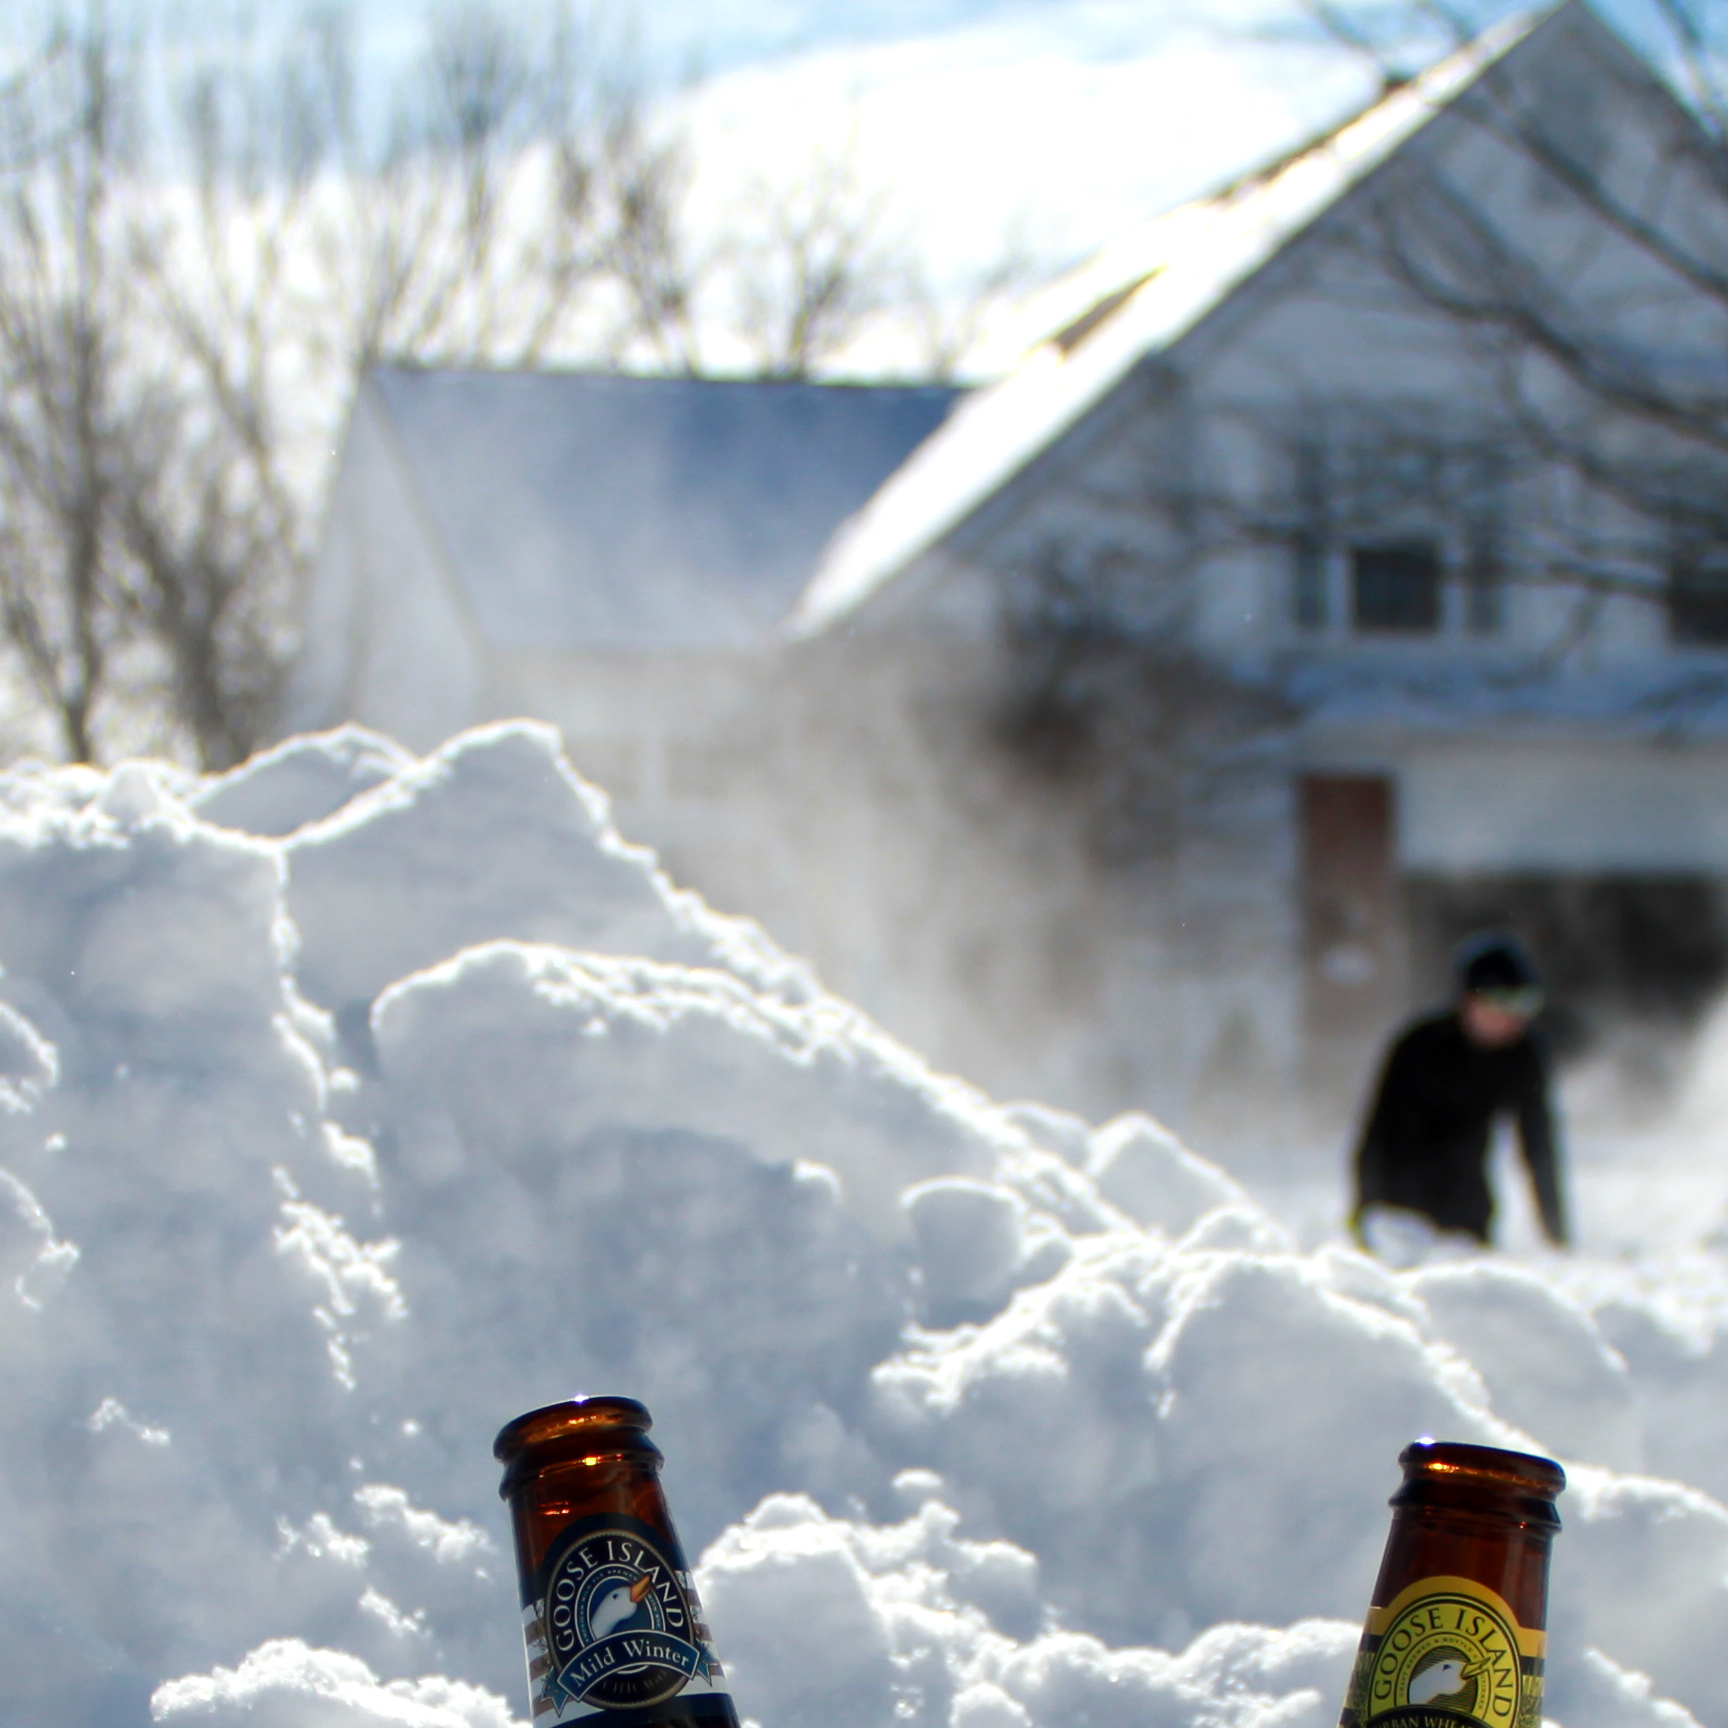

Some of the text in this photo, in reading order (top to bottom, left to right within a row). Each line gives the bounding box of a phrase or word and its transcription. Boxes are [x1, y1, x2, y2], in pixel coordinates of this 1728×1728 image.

[553, 1546, 599, 1652] GOOSE
[607, 1540, 684, 1628] ISLAND
[570, 1638, 690, 1688] Mild Winter
[1374, 1606, 1514, 1718] GOOSE ISLAND
